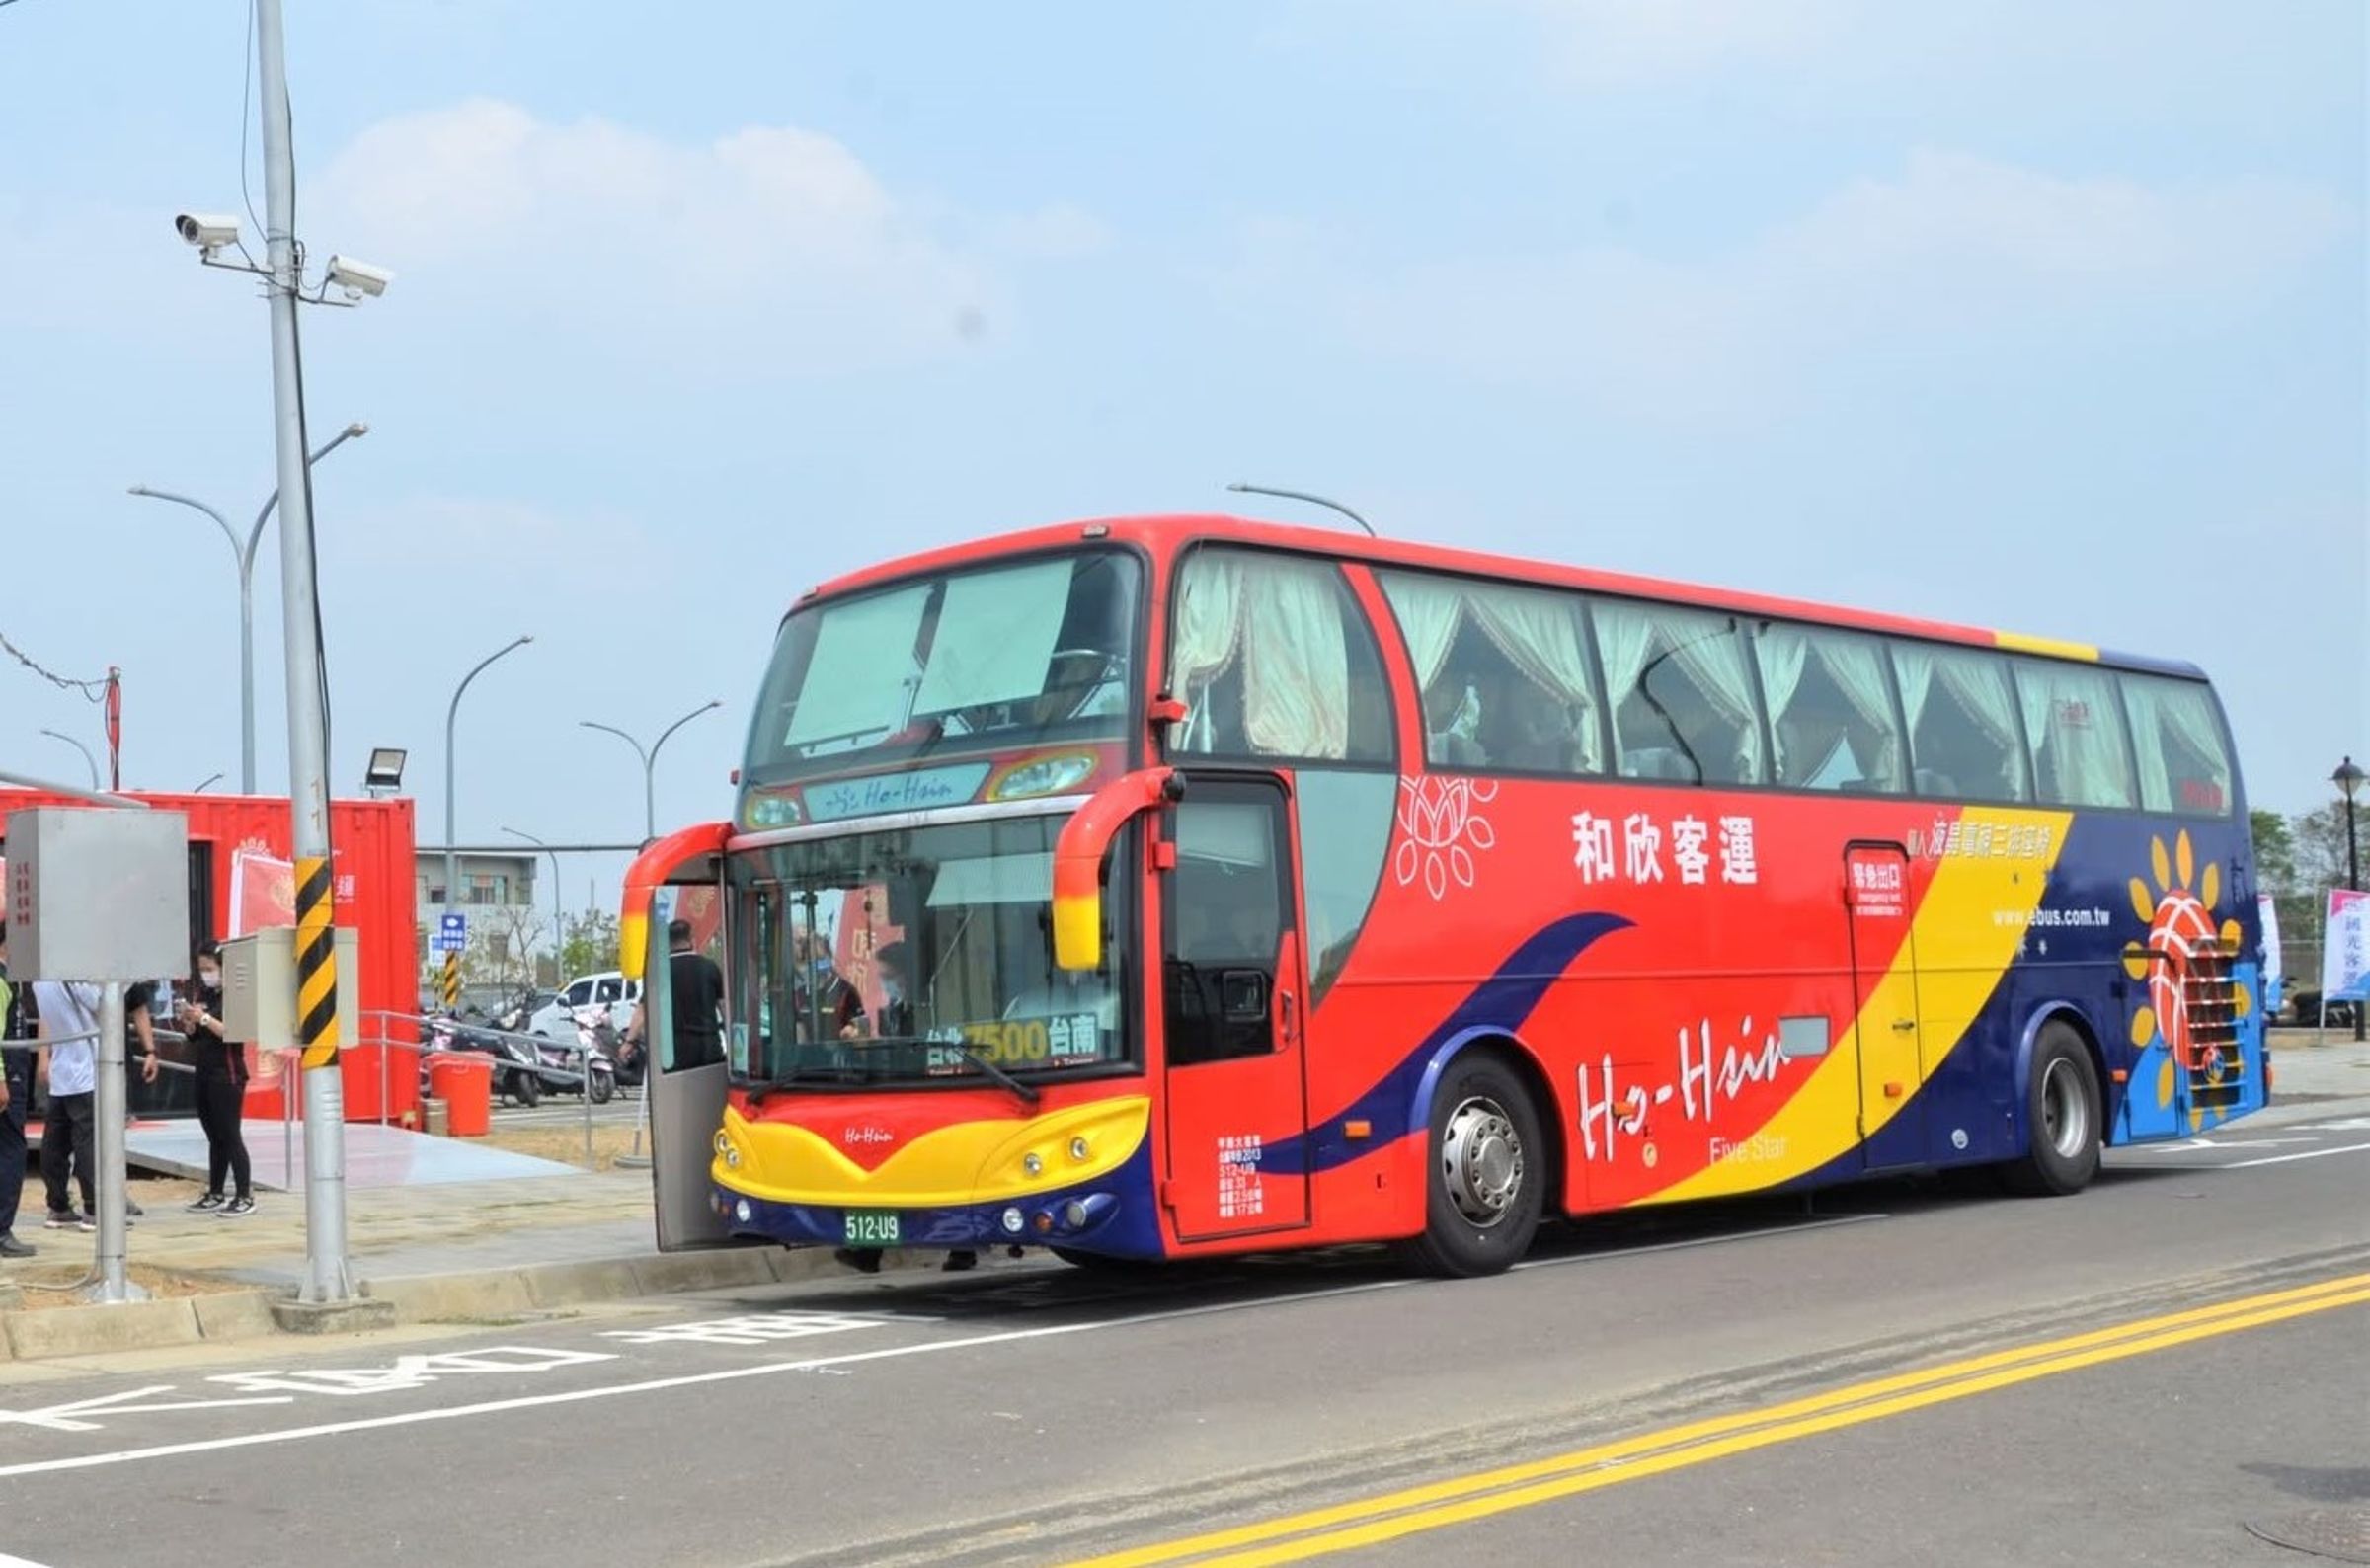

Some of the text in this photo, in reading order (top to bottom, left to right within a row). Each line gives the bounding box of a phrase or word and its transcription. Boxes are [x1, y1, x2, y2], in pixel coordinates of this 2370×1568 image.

[1571, 810, 1758, 885] 和欣客運
[1992, 906, 2110, 926] www.ebus.com.tw
[1049, 1013, 1096, 1056] 台南
[1578, 1014, 1792, 1163] Ho-Hsin
[1709, 1135, 1787, 1165] Five Star
